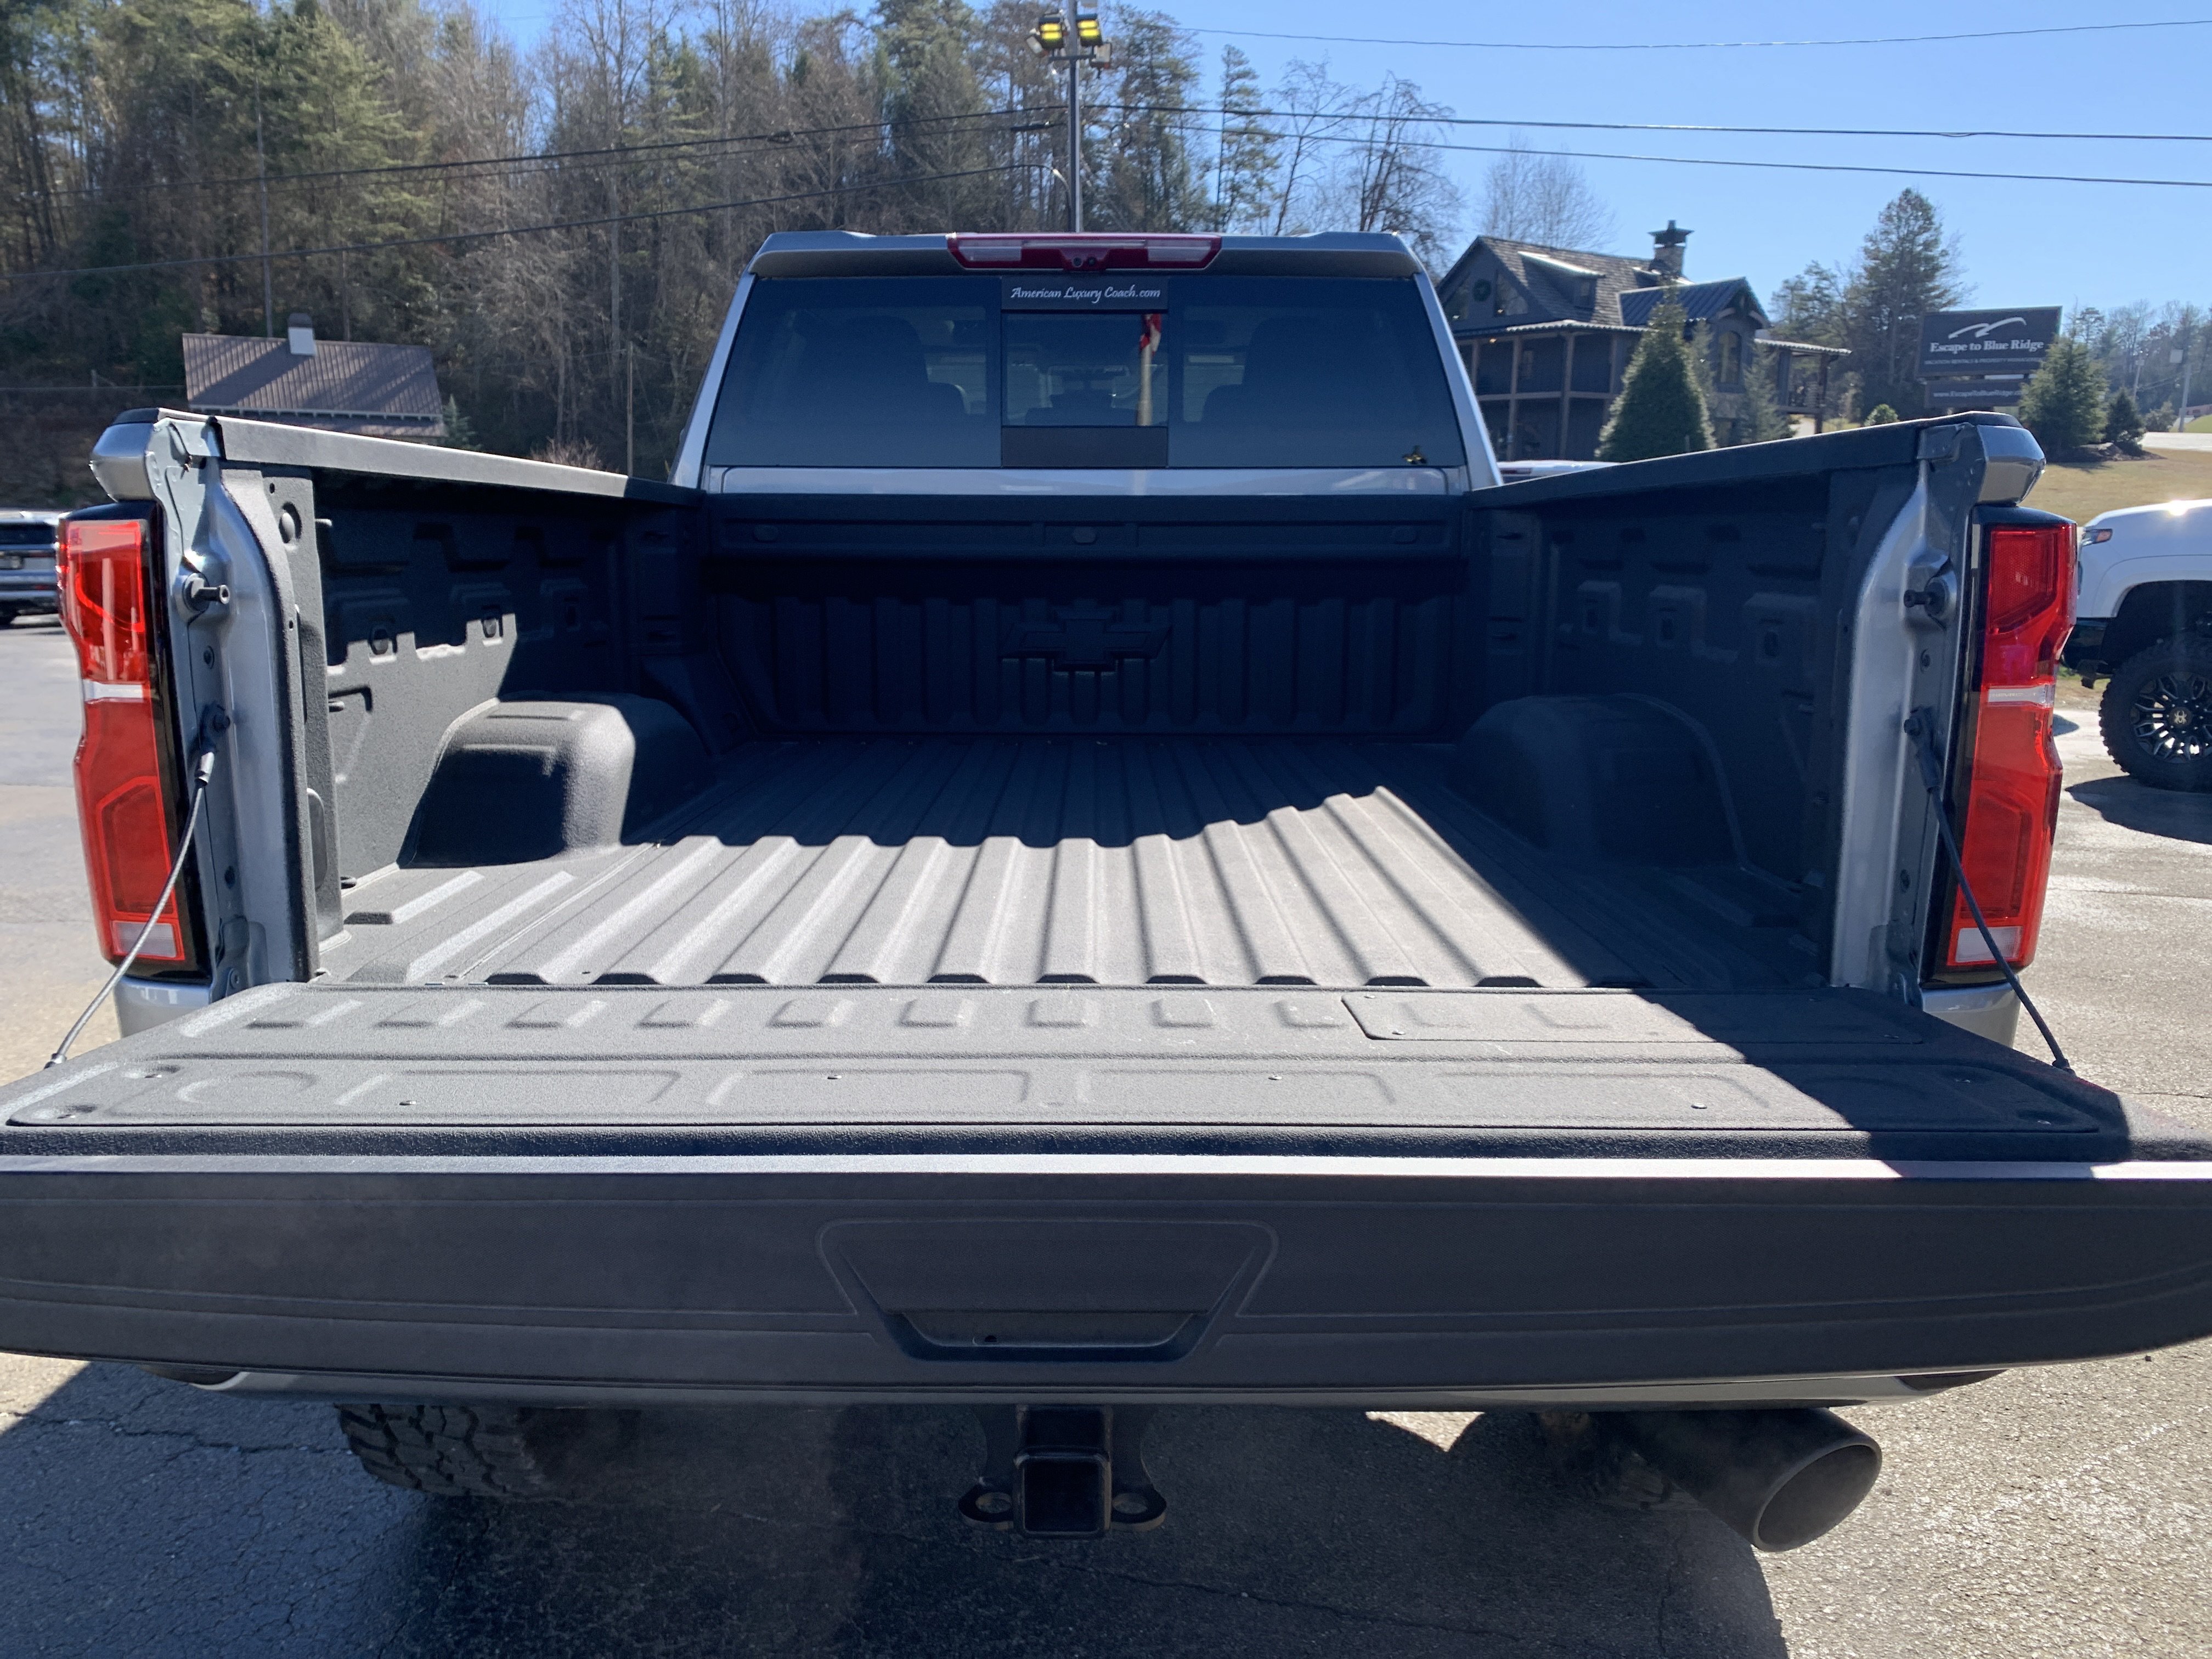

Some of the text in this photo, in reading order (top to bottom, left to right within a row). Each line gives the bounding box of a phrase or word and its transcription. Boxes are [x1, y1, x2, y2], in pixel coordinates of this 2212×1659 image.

[1011, 284, 1161, 304] American Luxury Coach.com
[1929, 339, 2045, 354] Escape to Blue Ridge
